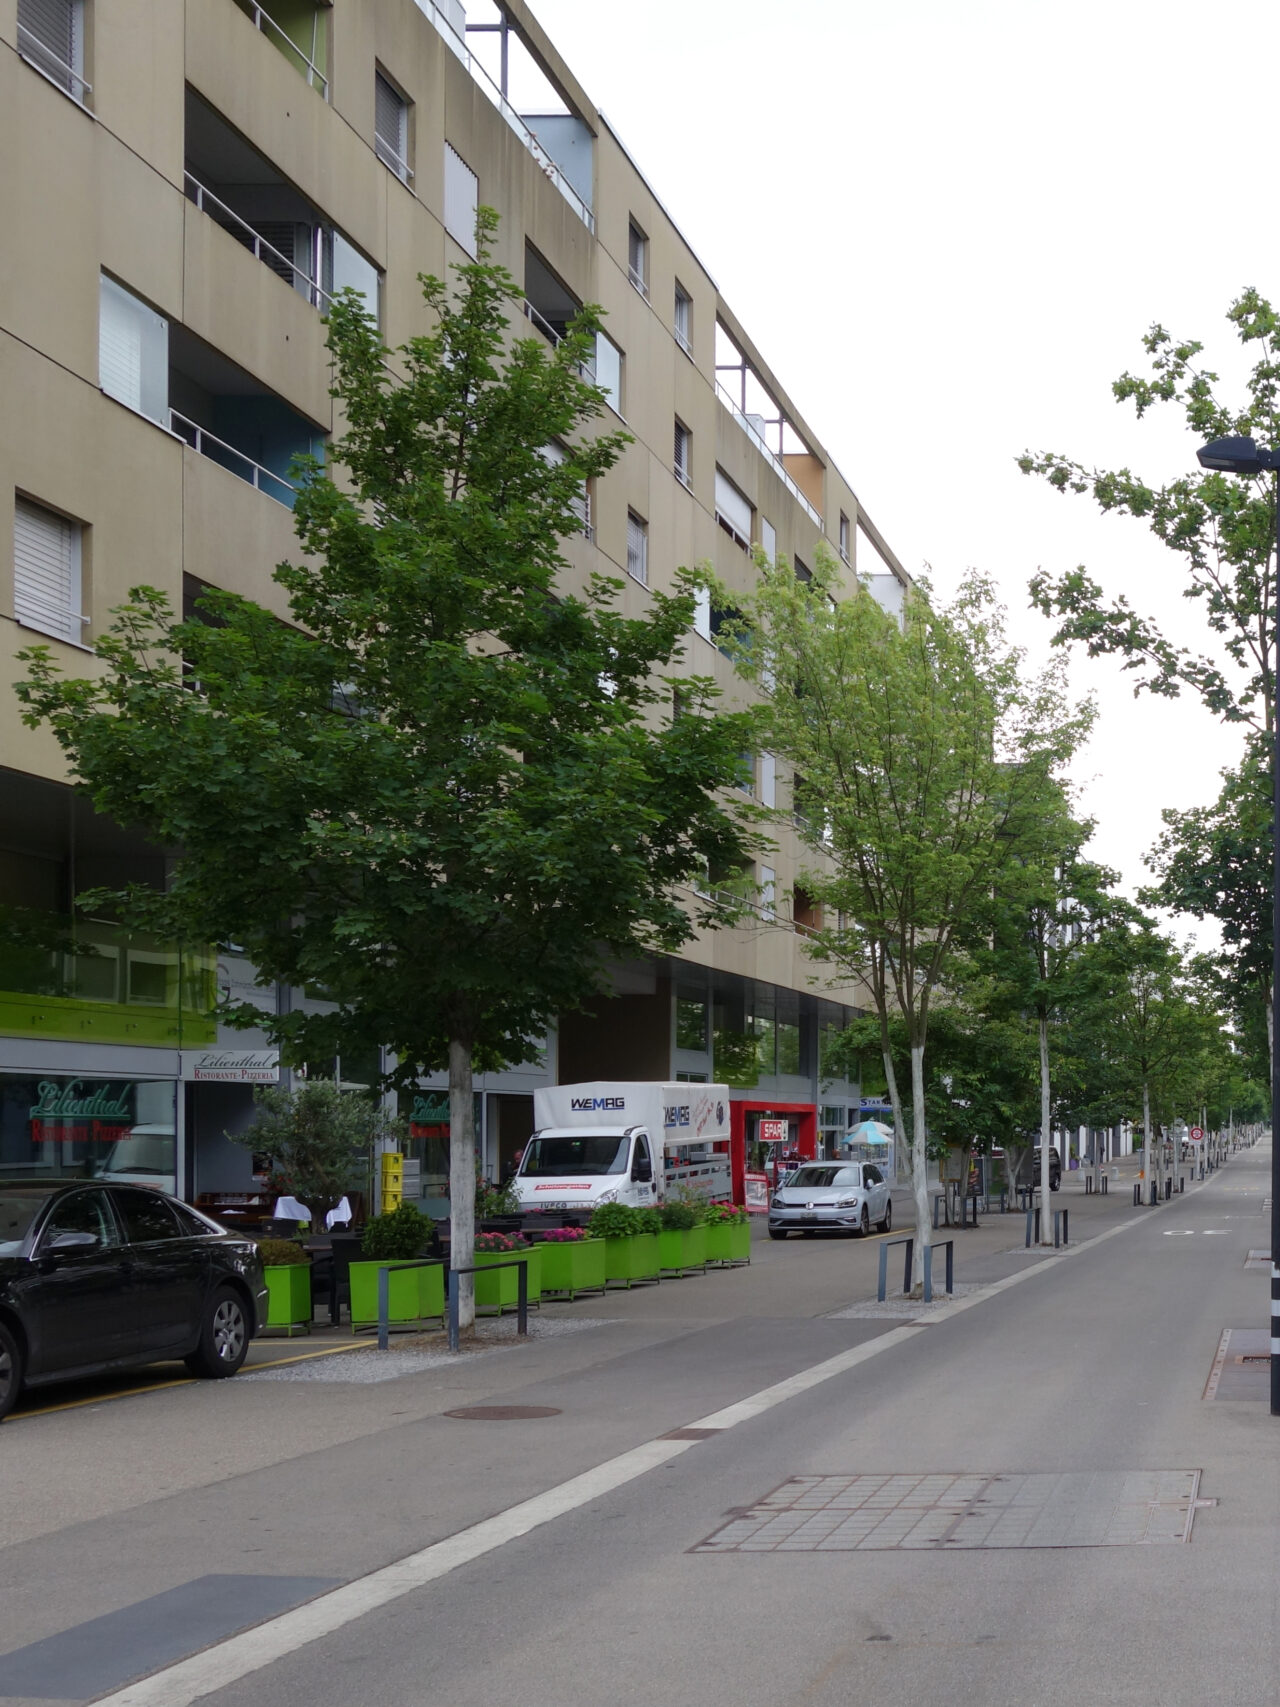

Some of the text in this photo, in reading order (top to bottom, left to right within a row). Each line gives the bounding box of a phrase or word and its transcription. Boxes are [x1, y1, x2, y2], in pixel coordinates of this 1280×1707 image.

[194, 1053, 276, 1068] Lilienthal
[30, 1079, 131, 1117] Lilienthal
[571, 1097, 625, 1110] WEMAG
[664, 1106, 690, 1124] WEMAG
[764, 1123, 782, 1137] SPAR
